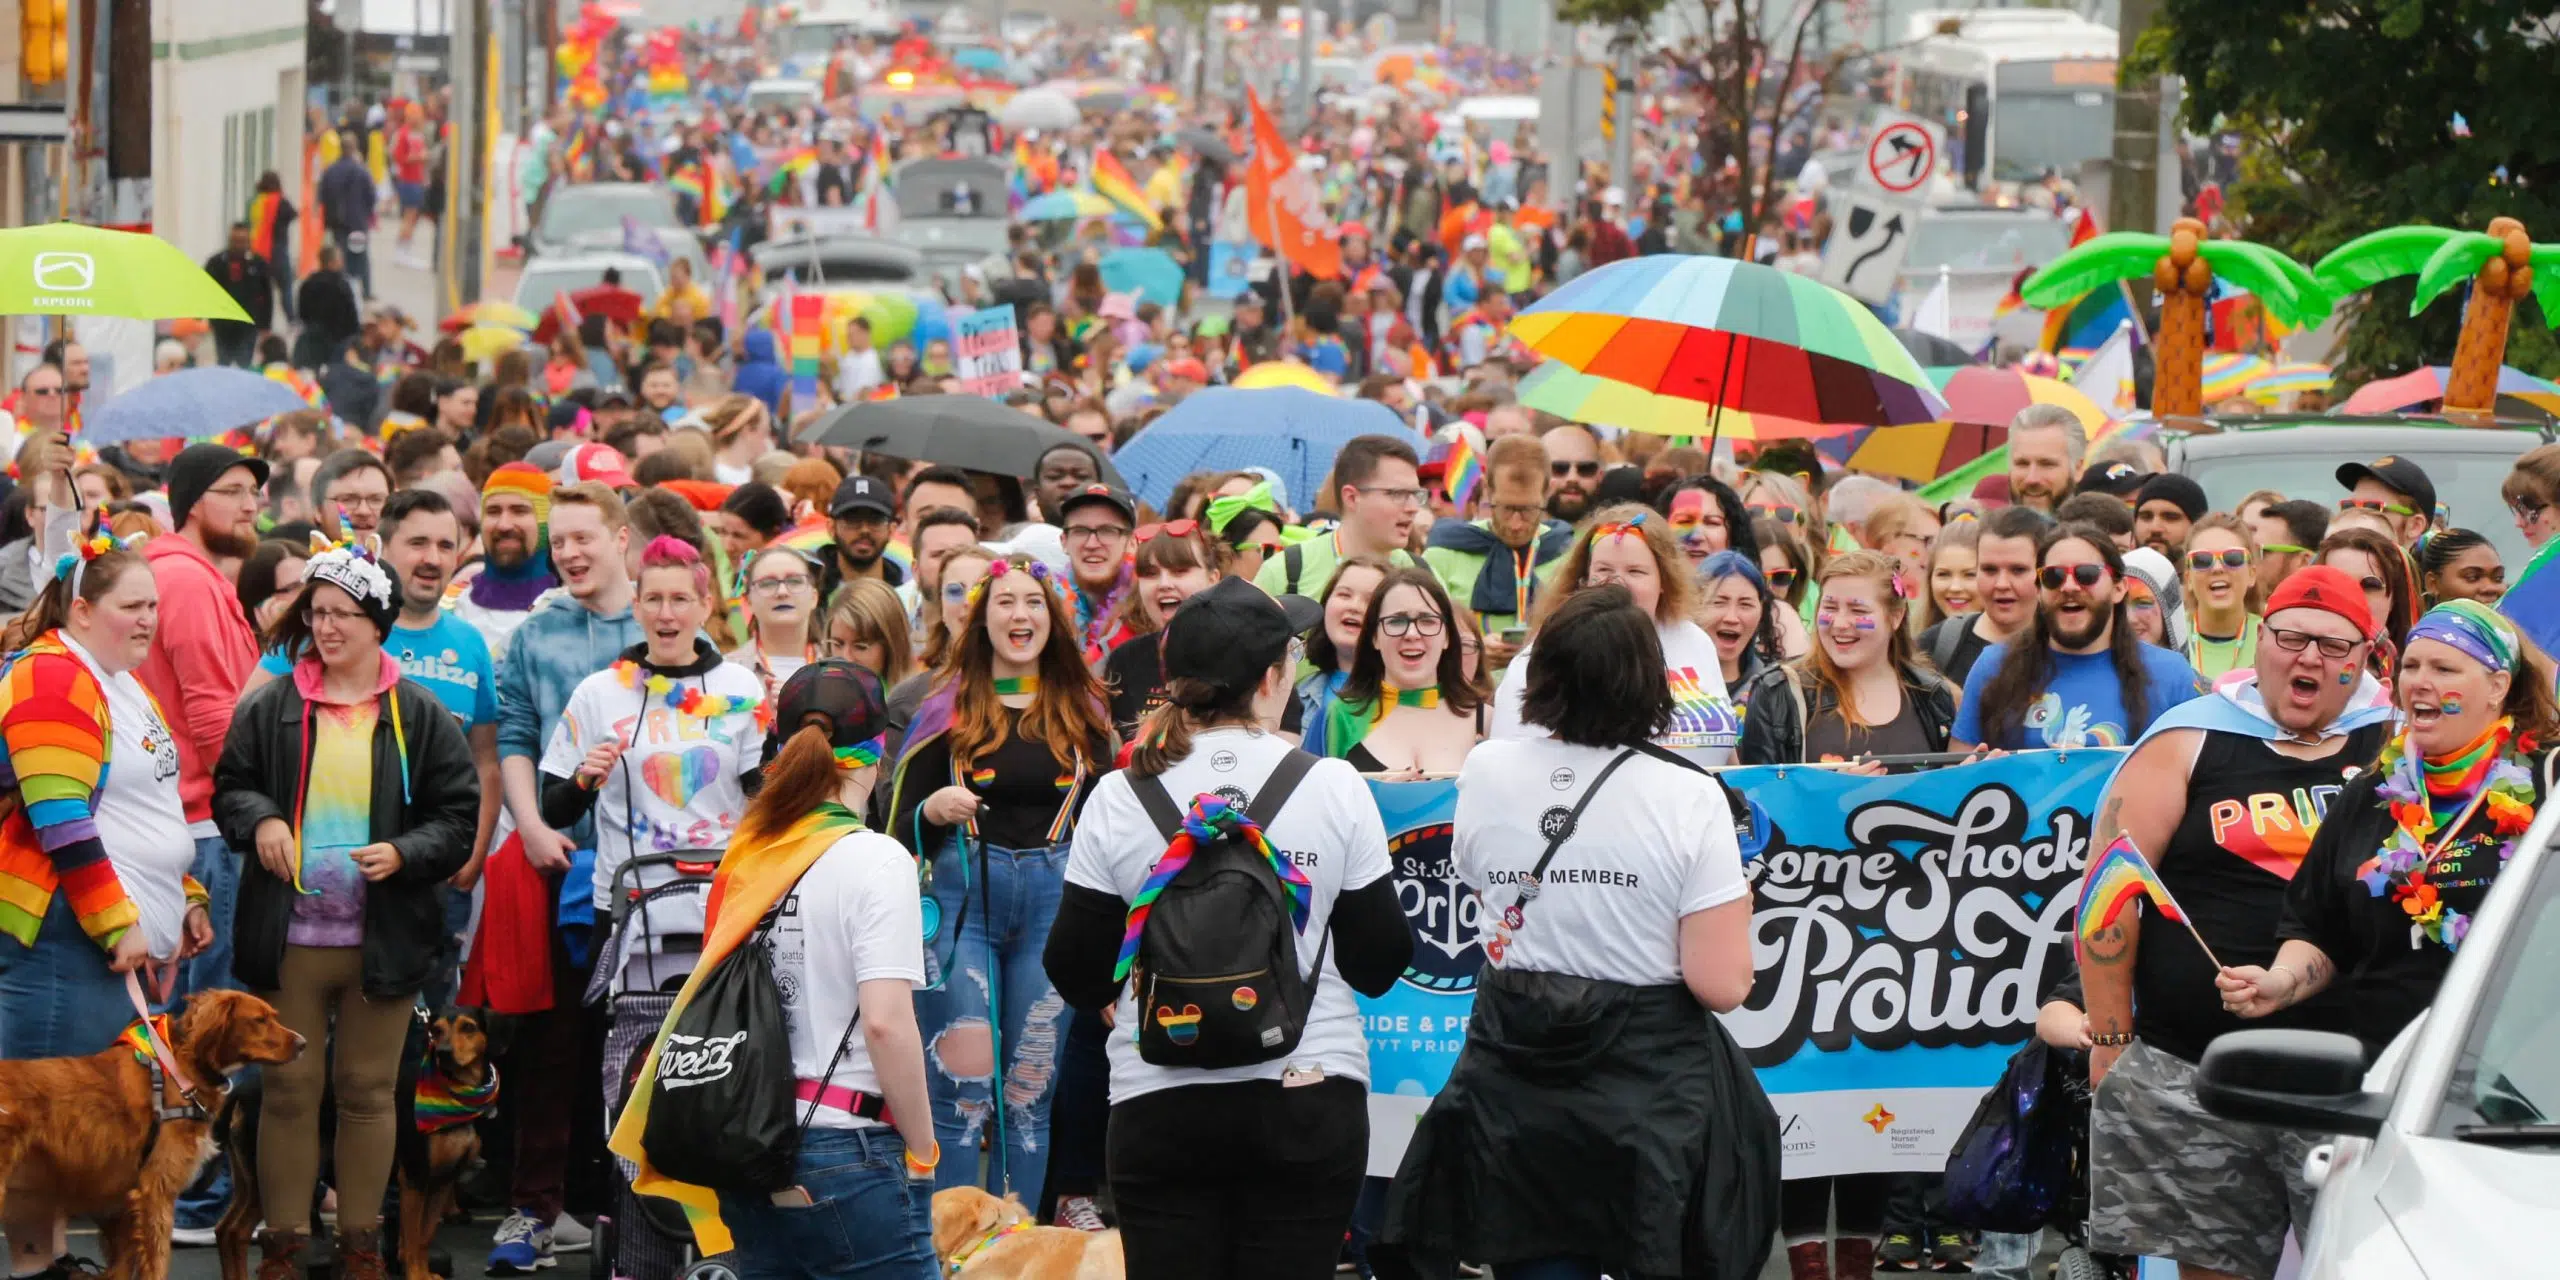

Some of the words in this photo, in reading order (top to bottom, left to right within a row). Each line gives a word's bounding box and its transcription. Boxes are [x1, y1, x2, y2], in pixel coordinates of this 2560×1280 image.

[33, 297, 94, 307] EXPLORE
[392, 655, 479, 690] alize
[612, 708, 733, 749] FREE
[2210, 784, 2343, 844] PRID
[1280, 850, 1319, 867] BER
[1550, 869, 1639, 888] MEMBER
[1744, 848, 1897, 911] ome
[1715, 877, 2086, 1049] Proud
[1357, 1015, 1410, 1032] RIDE
[1419, 1015, 1434, 1032] &
[1411, 1039, 1461, 1053] PRID
[1781, 1140, 1816, 1151] oms
